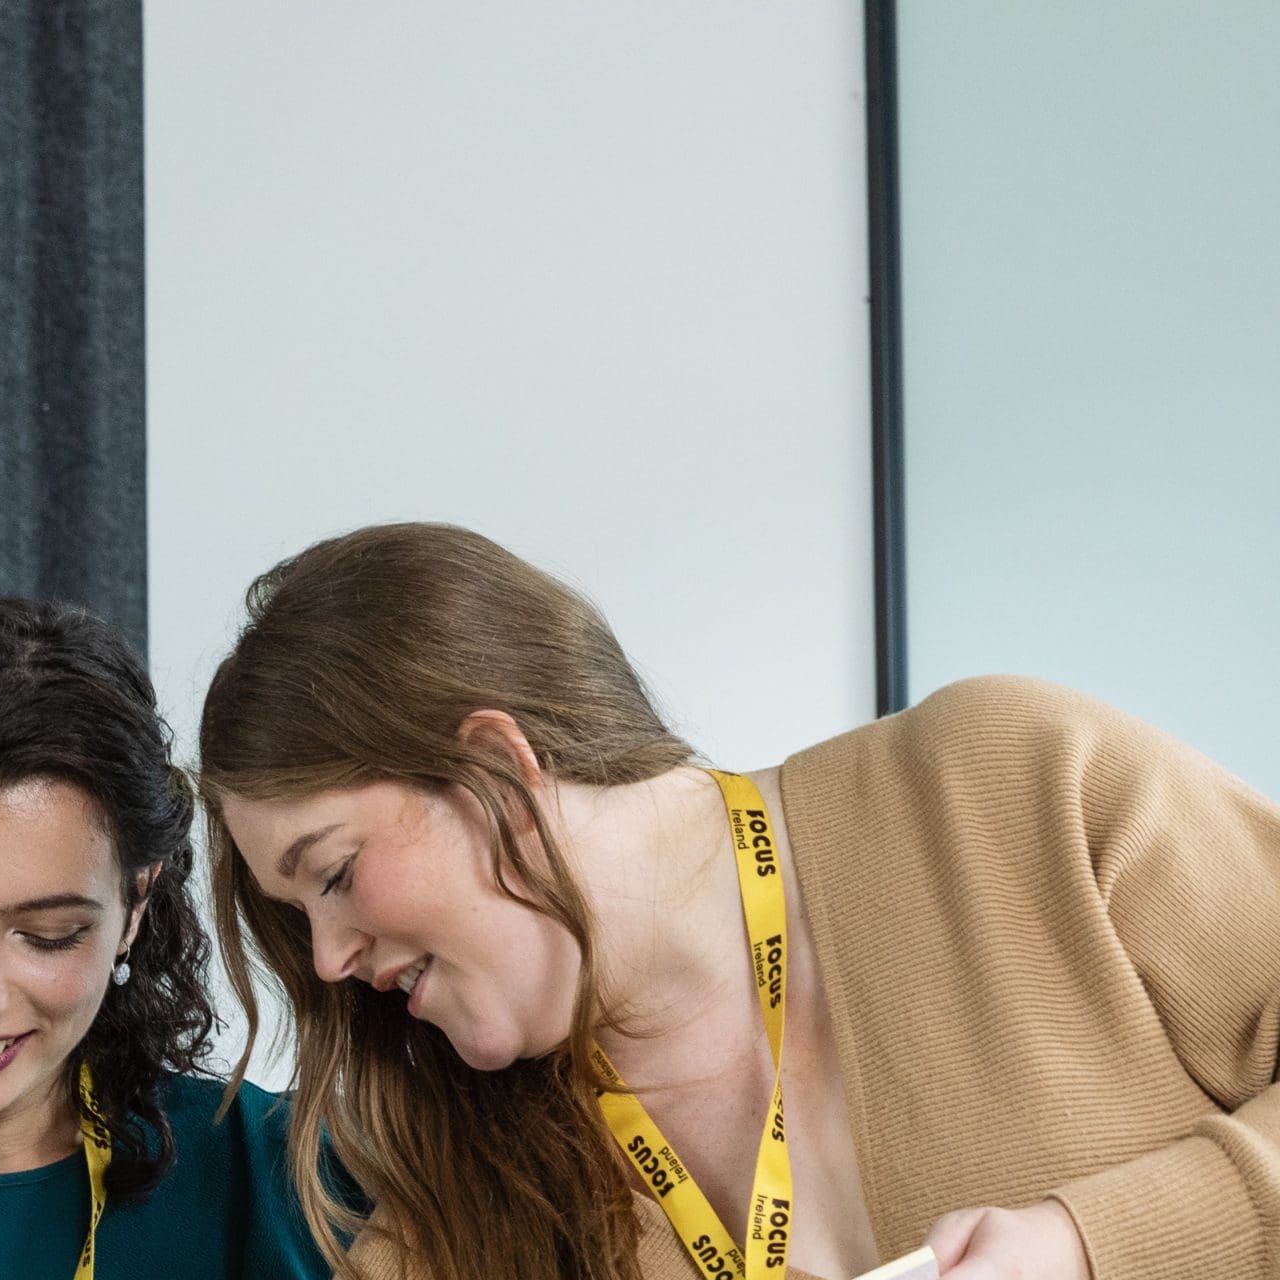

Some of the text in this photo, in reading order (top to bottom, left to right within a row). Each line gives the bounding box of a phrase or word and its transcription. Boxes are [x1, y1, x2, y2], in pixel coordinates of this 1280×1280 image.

[731, 809, 749, 850] Ireland
[746, 809, 776, 877] FOCUS
[753, 941, 767, 988] Ireland
[766, 933, 782, 1009] FOCUS
[628, 1135, 675, 1198] FOCUS
[658, 1146, 689, 1184] Ireland
[752, 1194, 768, 1241] Ireland
[766, 1198, 790, 1269] FOCUS
